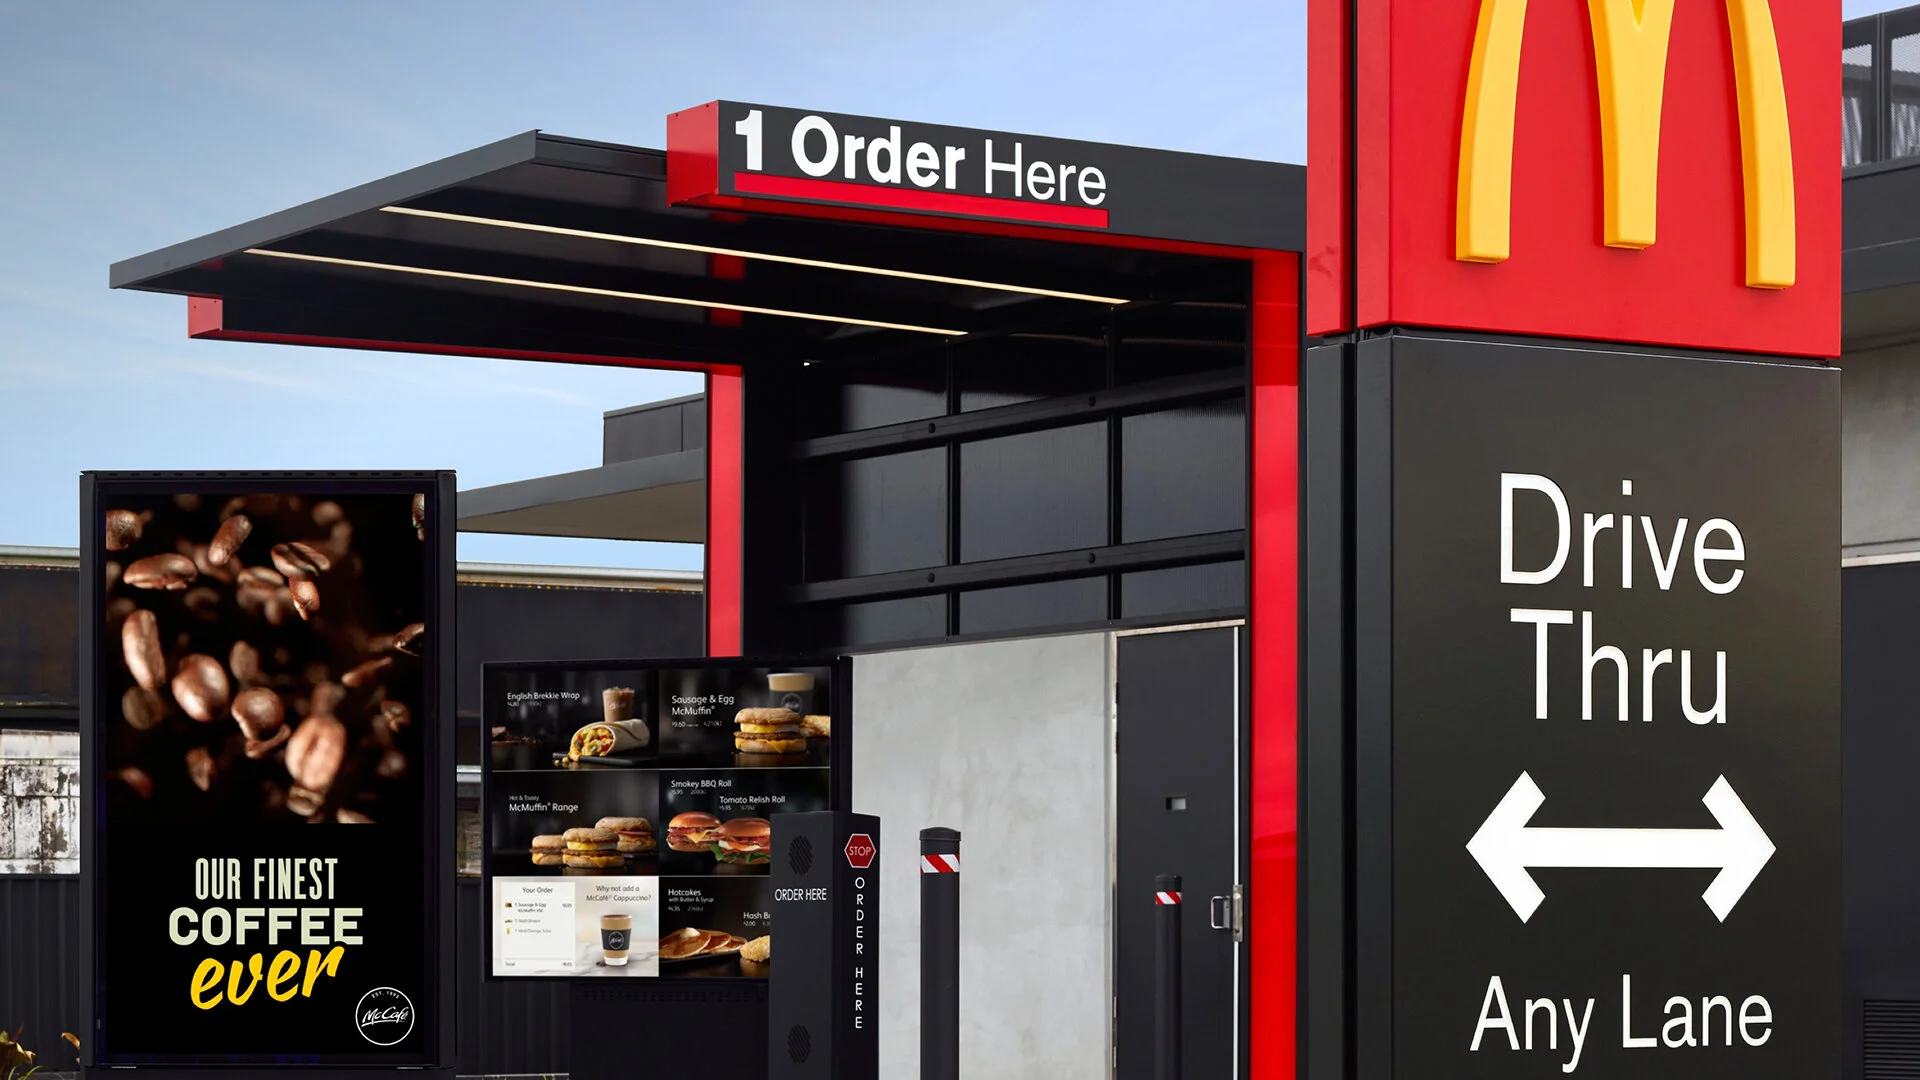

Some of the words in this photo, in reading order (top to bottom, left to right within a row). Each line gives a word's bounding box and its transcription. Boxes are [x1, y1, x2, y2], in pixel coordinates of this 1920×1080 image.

[735, 109, 764, 172] 1
[791, 114, 966, 190] Order
[984, 138, 1107, 206] Here
[1500, 472, 1746, 595] Drive
[1510, 608, 1727, 725] Thru
[507, 692, 532, 701] English
[533, 691, 559, 700] Brekkie
[560, 691, 580, 700] Wrap
[671, 695, 708, 706] Sausage
[709, 694, 717, 704] &
[718, 694, 735, 706] Egg
[671, 780, 700, 789] Smokey
[700, 780, 717, 788] BBQ
[718, 779, 732, 788] Roll
[552, 802, 579, 813] Range
[719, 796, 747, 804] Tomato
[749, 795, 770, 804] Relish
[771, 795, 786, 803] Roll
[849, 845, 872, 857] STOP
[194, 857, 242, 900] OUR
[253, 857, 339, 900] FINEST
[668, 888, 702, 897] Hotcakes
[774, 888, 804, 901] ORDER
[805, 888, 828, 901] HERE
[168, 906, 364, 946] COFFEE
[743, 911, 762, 920] Hash
[854, 876, 866, 955] ORDER
[189, 944, 346, 1011] ever
[855, 966, 864, 1029] HERE
[1469, 975, 1595, 1074] Any
[1621, 973, 1774, 1049] Lane
